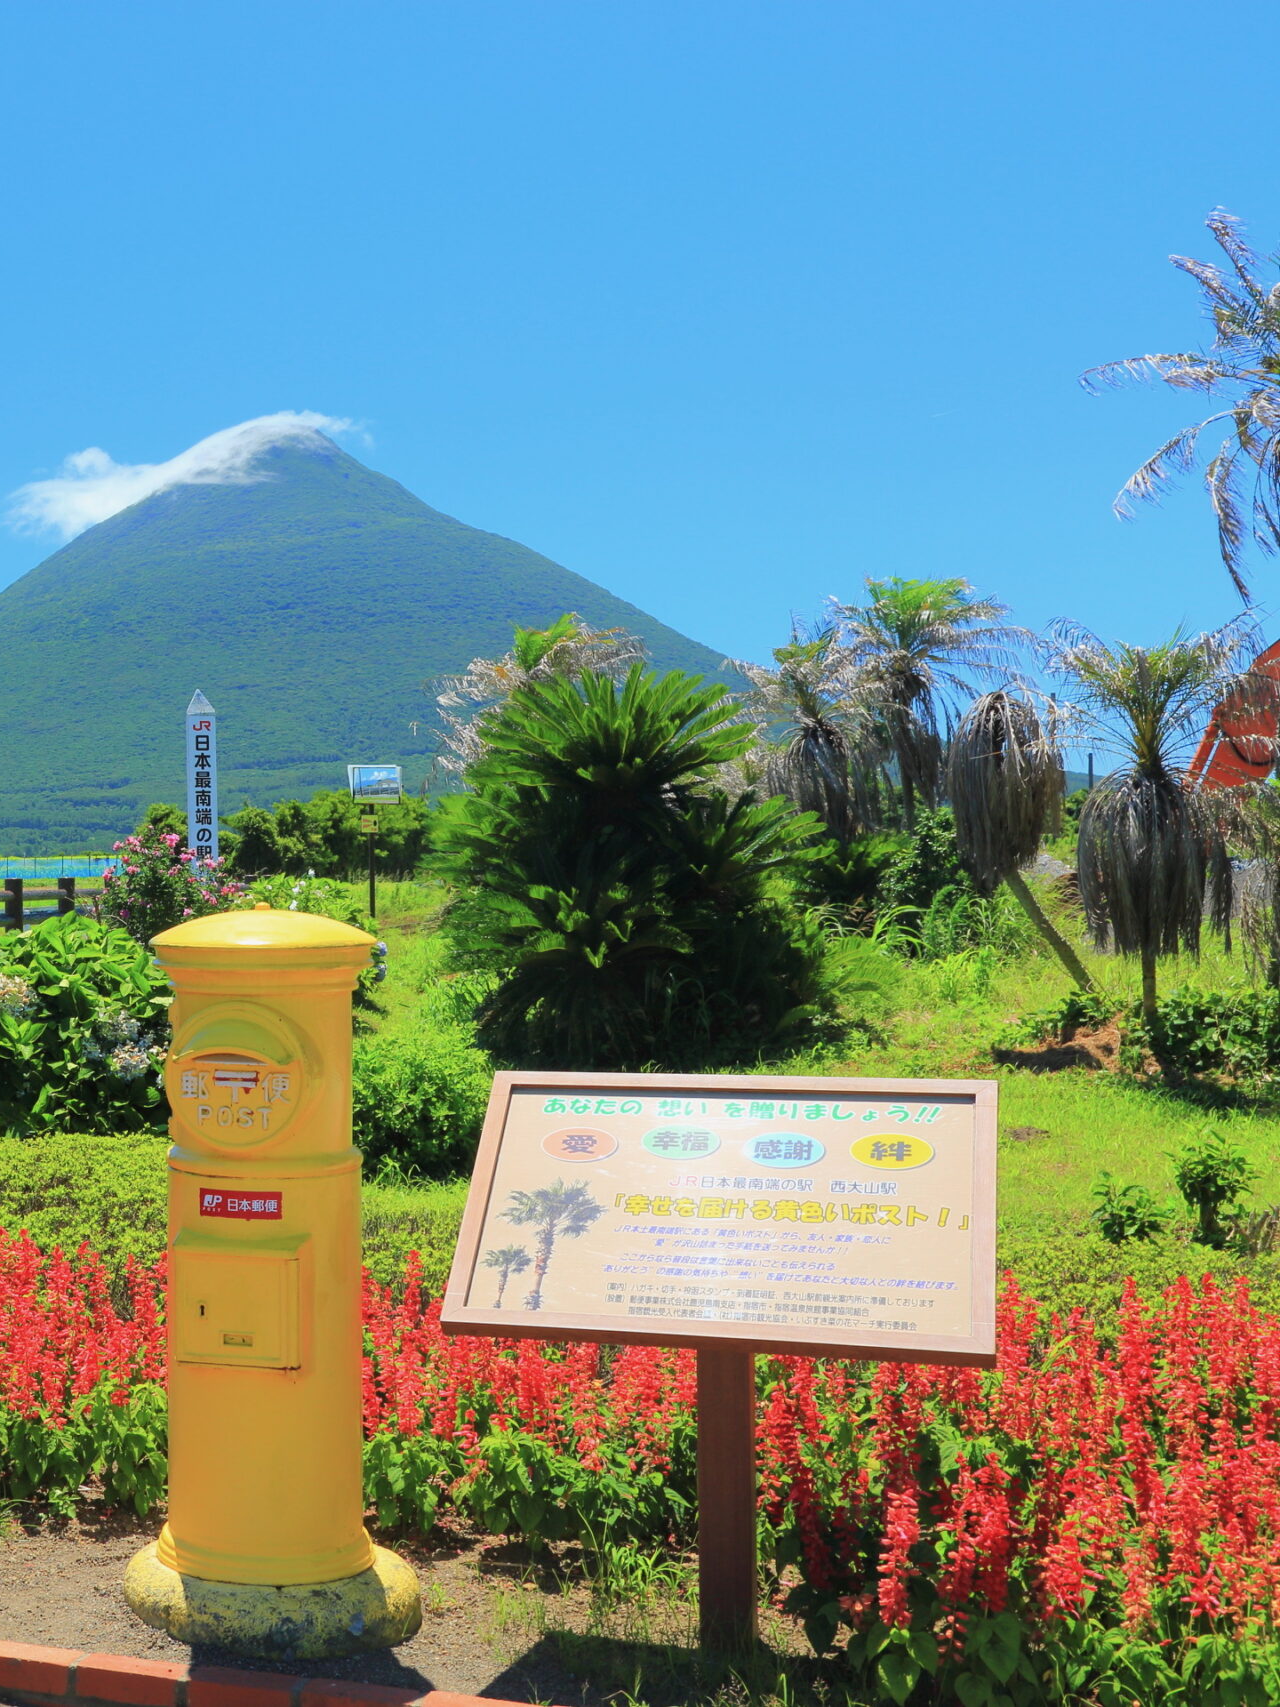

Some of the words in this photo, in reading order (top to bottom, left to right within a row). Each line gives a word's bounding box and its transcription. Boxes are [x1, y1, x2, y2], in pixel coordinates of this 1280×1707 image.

[193, 720, 211, 732] JR
[196, 1105, 273, 1130] POST
[543, 1098, 642, 1115] あなたの
[658, 1099, 708, 1117] 想い
[561, 1134, 597, 1154] 愛
[652, 1131, 710, 1151] 幸福
[754, 1139, 813, 1161] 感謝
[870, 1141, 912, 1161] 絆
[669, 1175, 813, 1192] JR日本最南端の駅
[830, 1180, 897, 1196] 西大山駅
[227, 1198, 278, 1212] 日本郵便
